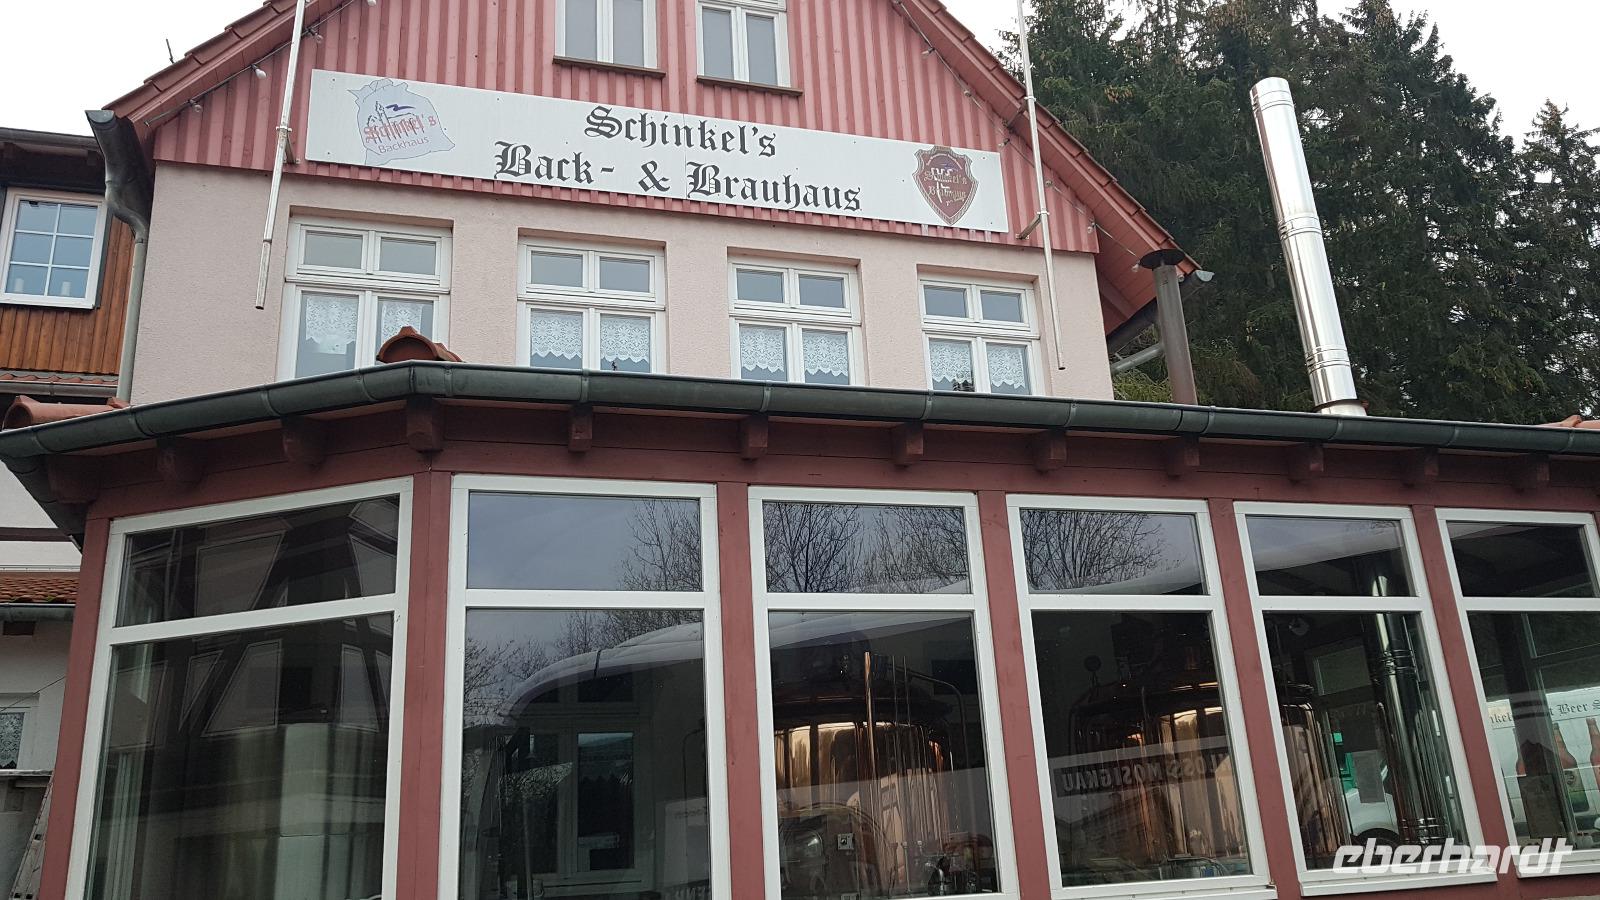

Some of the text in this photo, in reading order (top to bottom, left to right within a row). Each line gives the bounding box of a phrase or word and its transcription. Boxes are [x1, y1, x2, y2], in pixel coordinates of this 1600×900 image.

[378, 136, 430, 154] Backhaus
[584, 105, 777, 157] Schinkel's
[638, 160, 671, 193] &
[686, 160, 862, 212] Brauhaus
[1557, 703, 1588, 717] Beer
